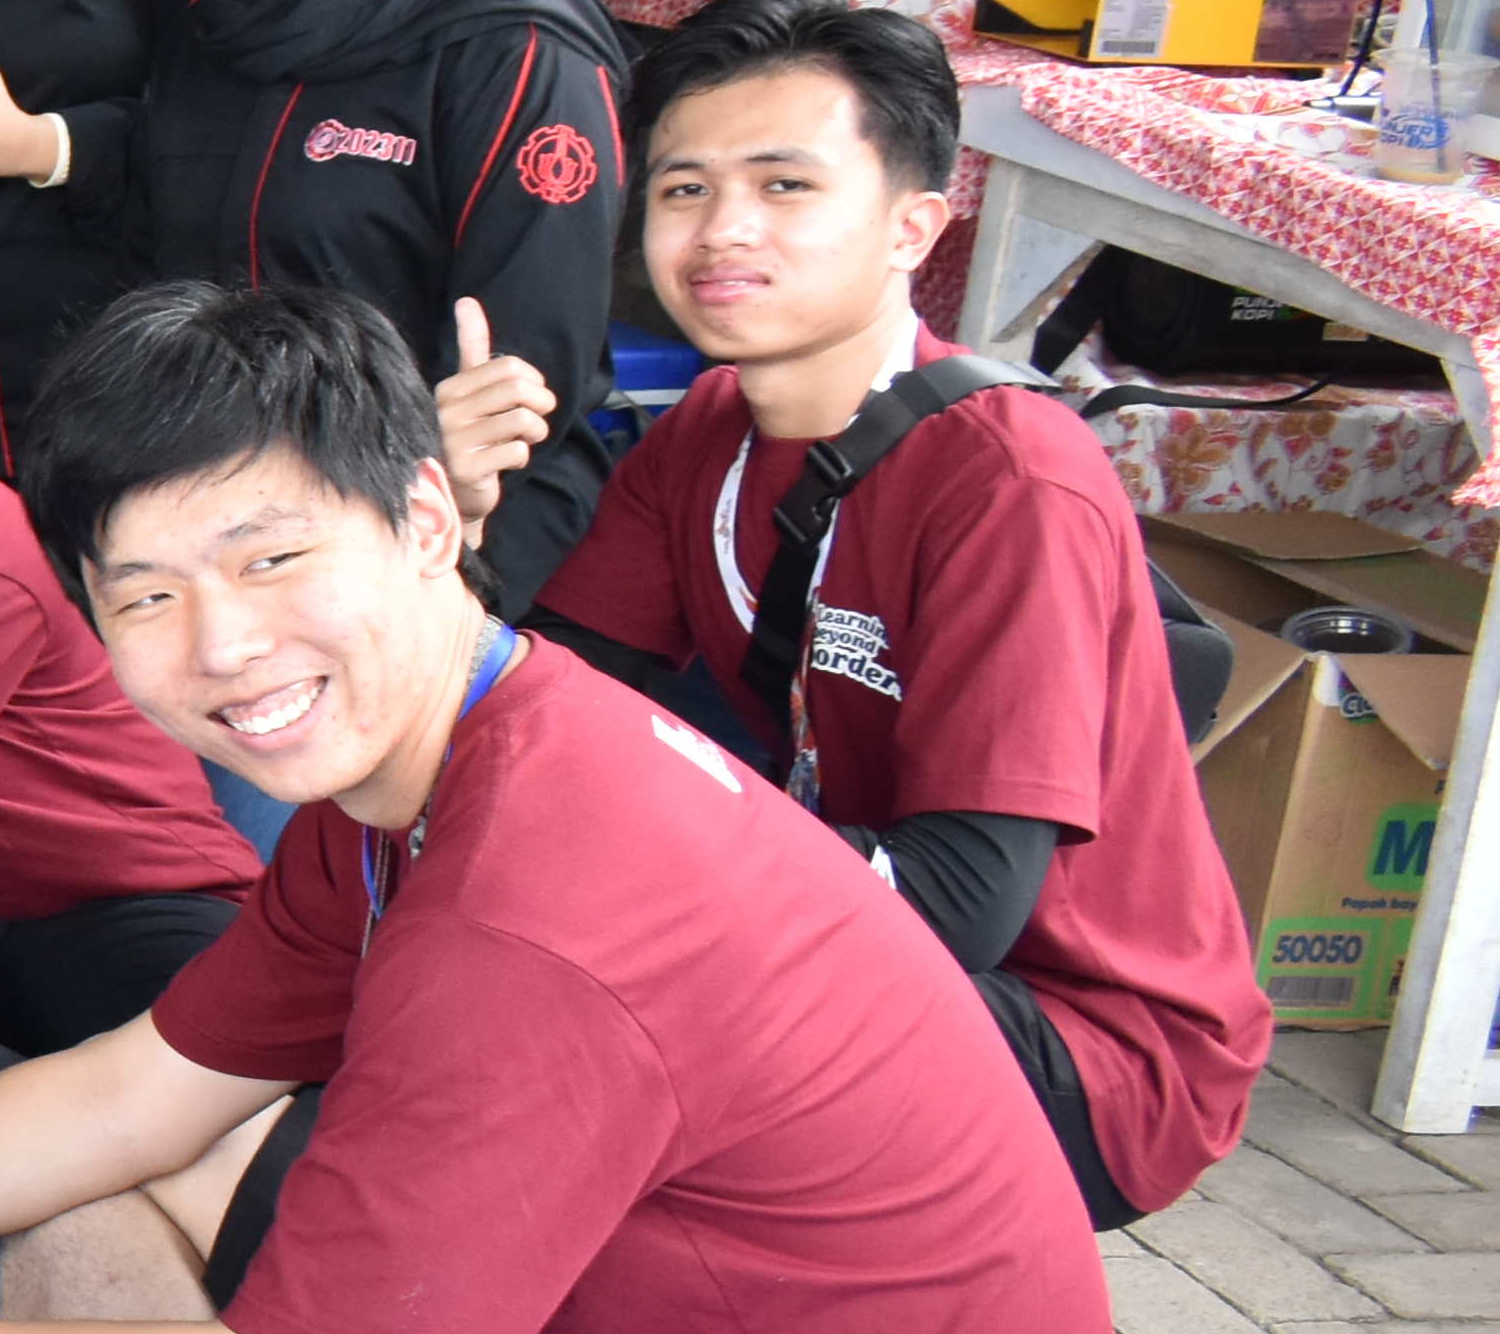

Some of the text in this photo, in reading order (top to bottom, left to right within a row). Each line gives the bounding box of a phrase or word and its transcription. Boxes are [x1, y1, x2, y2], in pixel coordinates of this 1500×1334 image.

[336, 126, 417, 166] 202311
[815, 628, 877, 654] eyond
[814, 648, 898, 690] order
[1342, 896, 1387, 911] Popok
[1271, 934, 1363, 965] 50050
